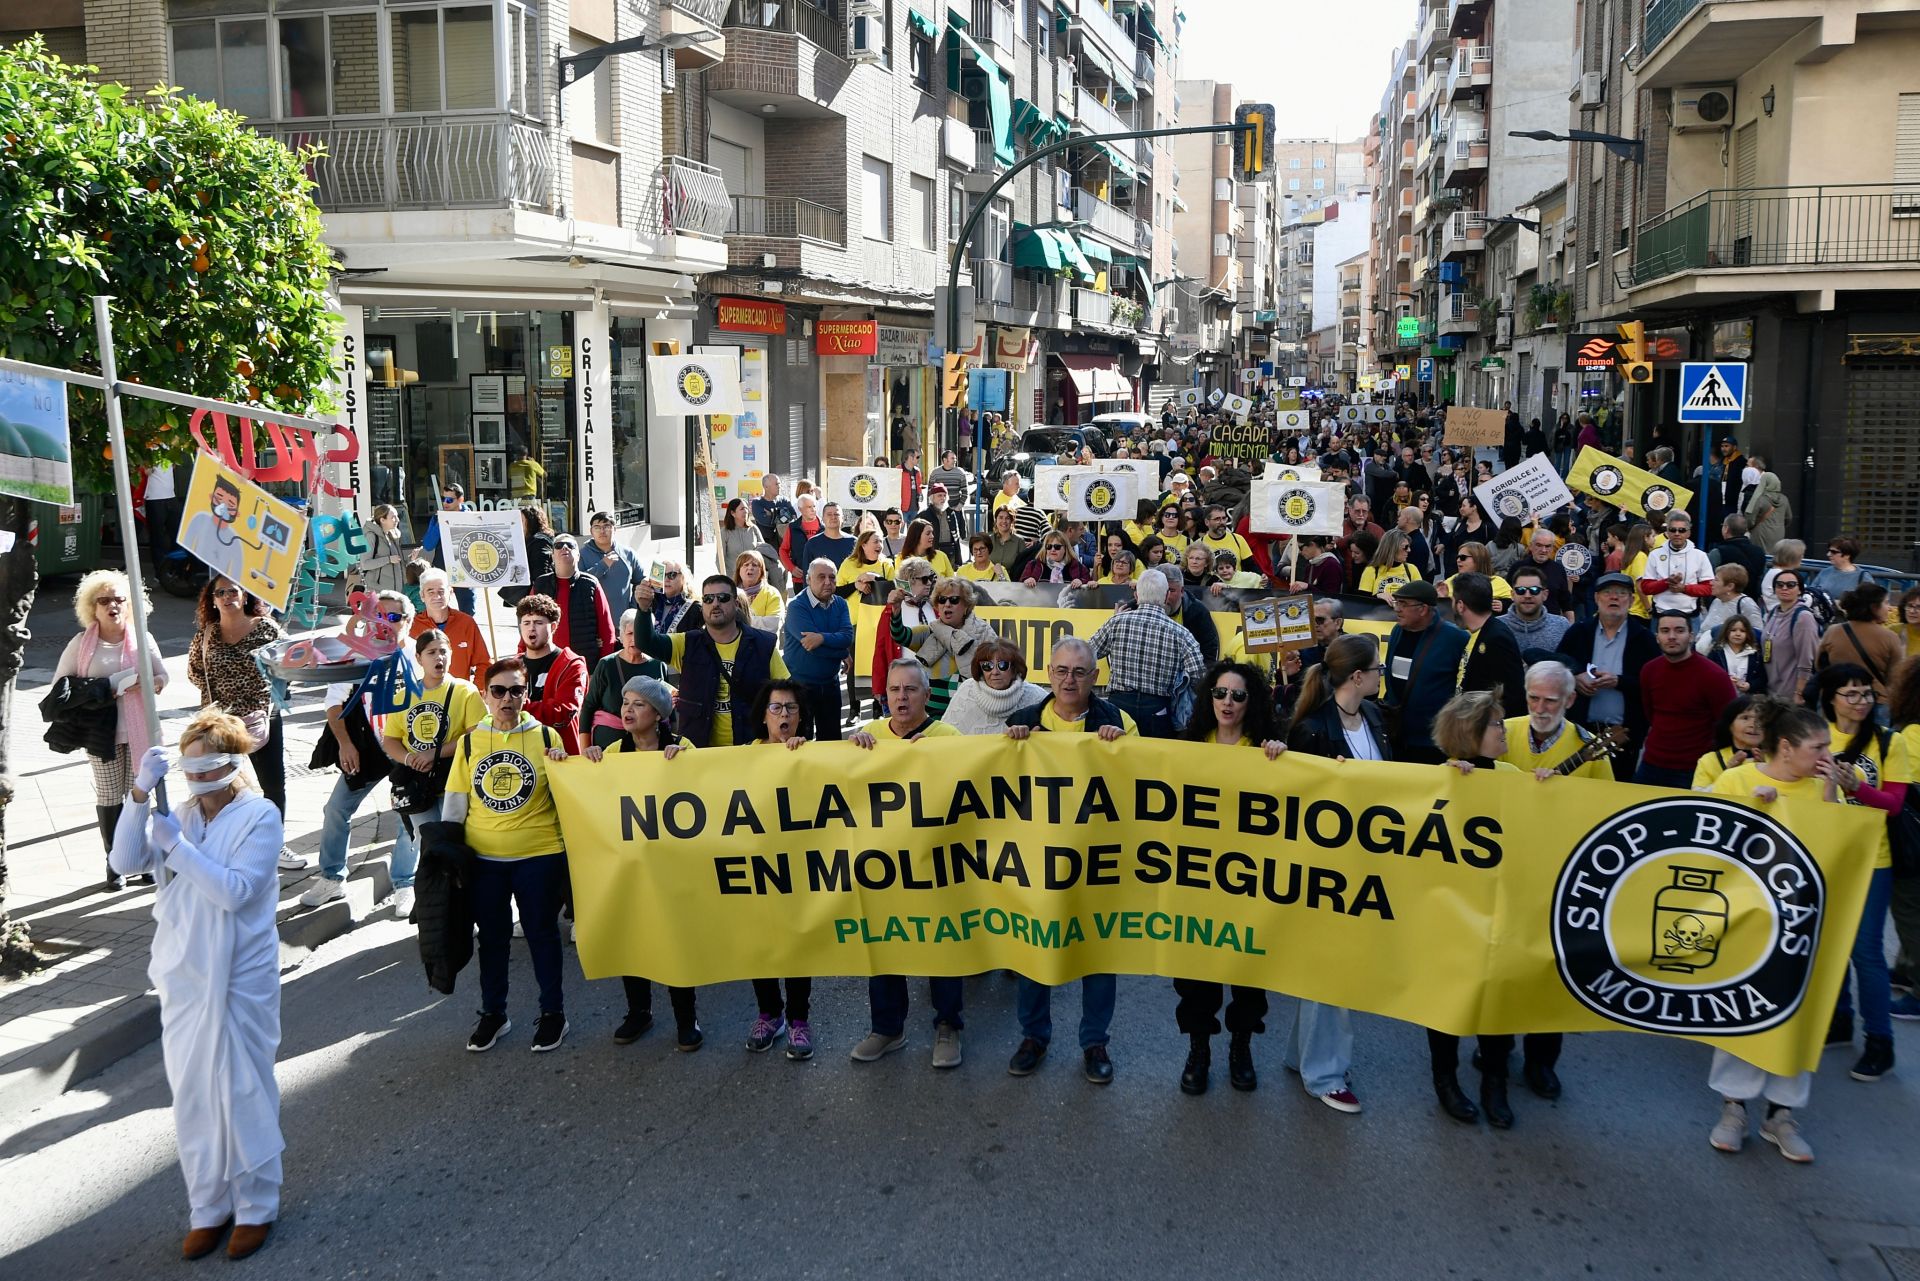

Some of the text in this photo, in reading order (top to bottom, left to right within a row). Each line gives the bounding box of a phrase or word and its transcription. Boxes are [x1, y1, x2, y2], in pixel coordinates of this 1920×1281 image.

[720, 306, 766, 326] SUPERMERCADO
[819, 324, 873, 334] SUPERMERCADO
[880, 329, 899, 341] BAZAR
[830, 335, 861, 353] Xiao
[1421, 360, 1430, 371] P
[1577, 357, 1614, 366] fibramol
[581, 338, 596, 513] CRISTALERIA
[1213, 425, 1269, 443] CAGADA
[1490, 470, 1531, 495] AGRIDULCE
[460, 536, 471, 559] STOP
[477, 532, 507, 560] BIOGAS
[469, 568, 505, 582] MOLINA
[474, 758, 494, 786] STOP
[502, 753, 533, 786] BIOGAS
[481, 794, 526, 810] MOLINA
[620, 775, 1504, 869] NO A LA PLANTA DE BIOGÁS
[714, 839, 1395, 921] EN MOLINA DE SEGURA
[1567, 822, 1648, 930] STOP
[834, 907, 1267, 956] PLATAFORMA VECINAL
[1585, 968, 1779, 1024] MOLINA
